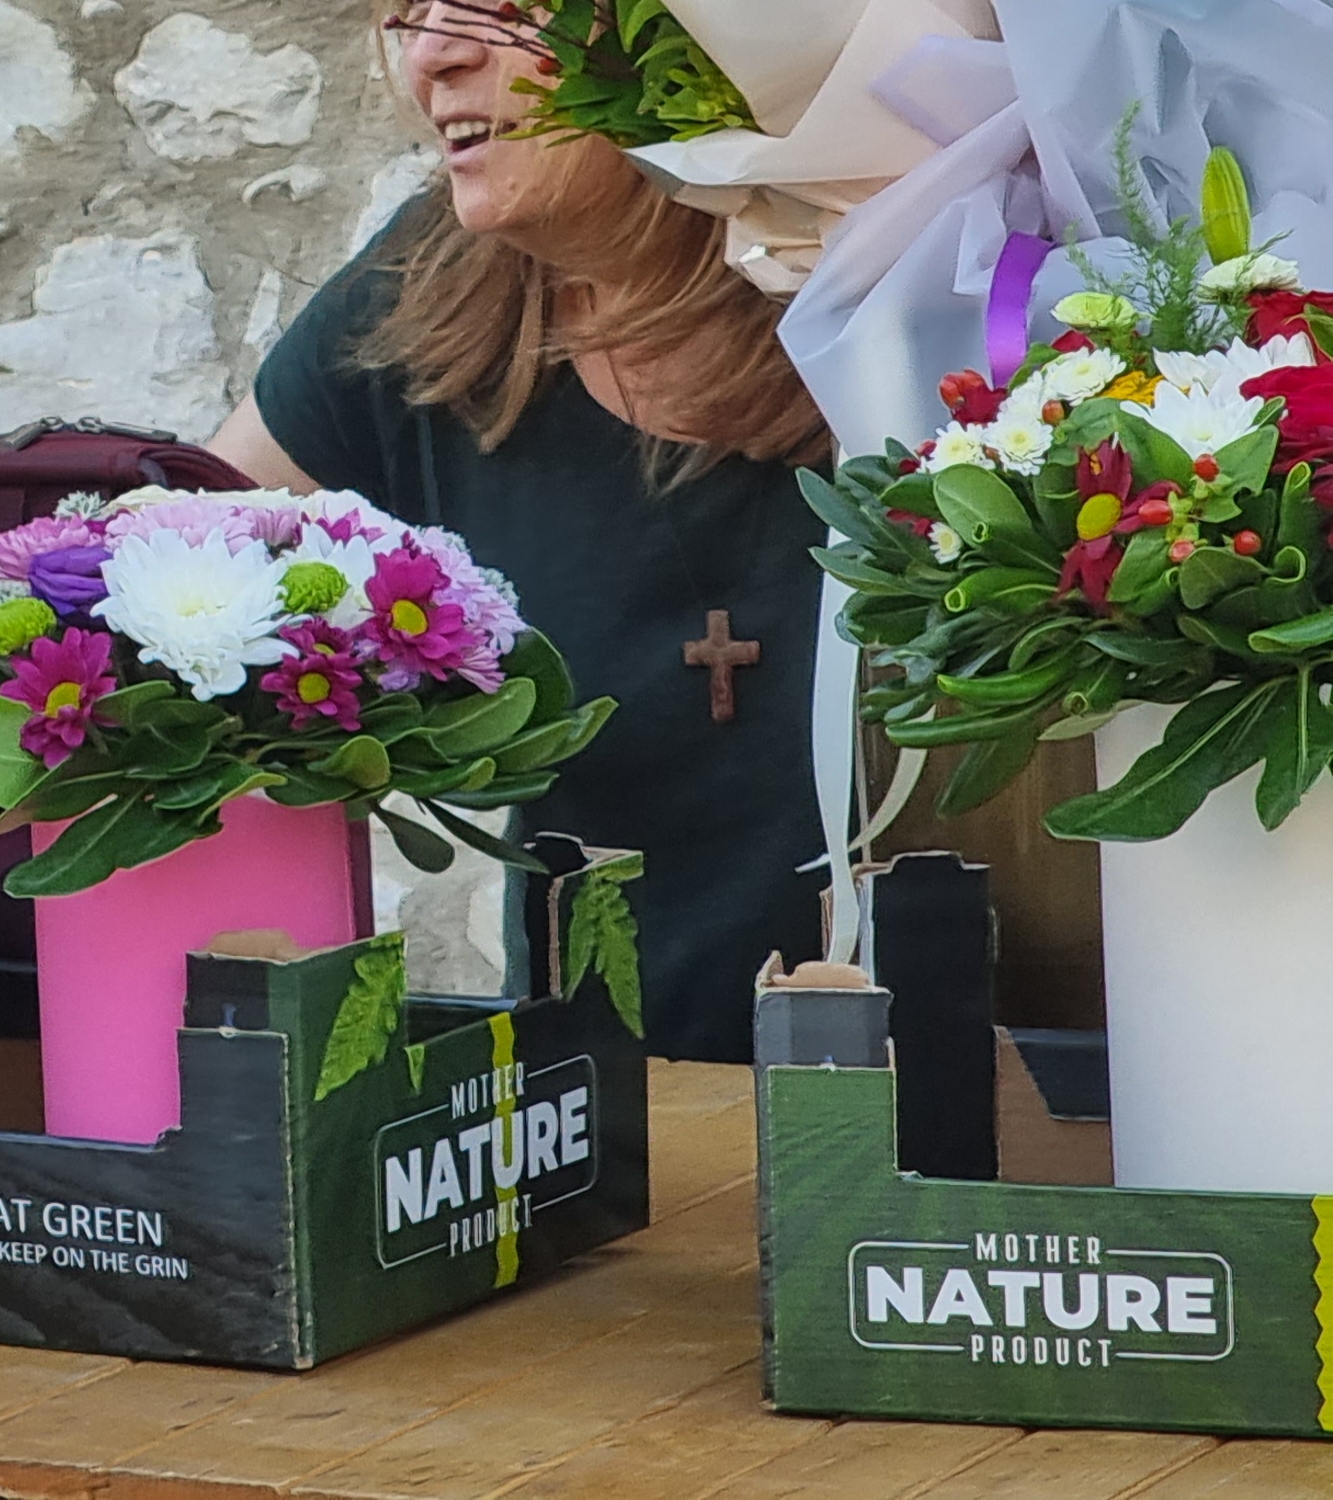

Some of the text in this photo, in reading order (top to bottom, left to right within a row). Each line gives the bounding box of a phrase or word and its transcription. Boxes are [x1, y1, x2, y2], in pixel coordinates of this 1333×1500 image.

[451, 1062, 525, 1119] MOTHER
[385, 1086, 589, 1233] NATURE
[42, 1202, 162, 1246] GREEN
[450, 1192, 533, 1258] PRODUCT
[975, 1232, 1102, 1265] MOTHER
[52, 1246, 85, 1268] ON
[90, 1249, 130, 1273] THE
[135, 1254, 189, 1279] GRIN
[866, 1265, 1217, 1335] NATURE
[970, 1334, 1113, 1367] PRODUCT
